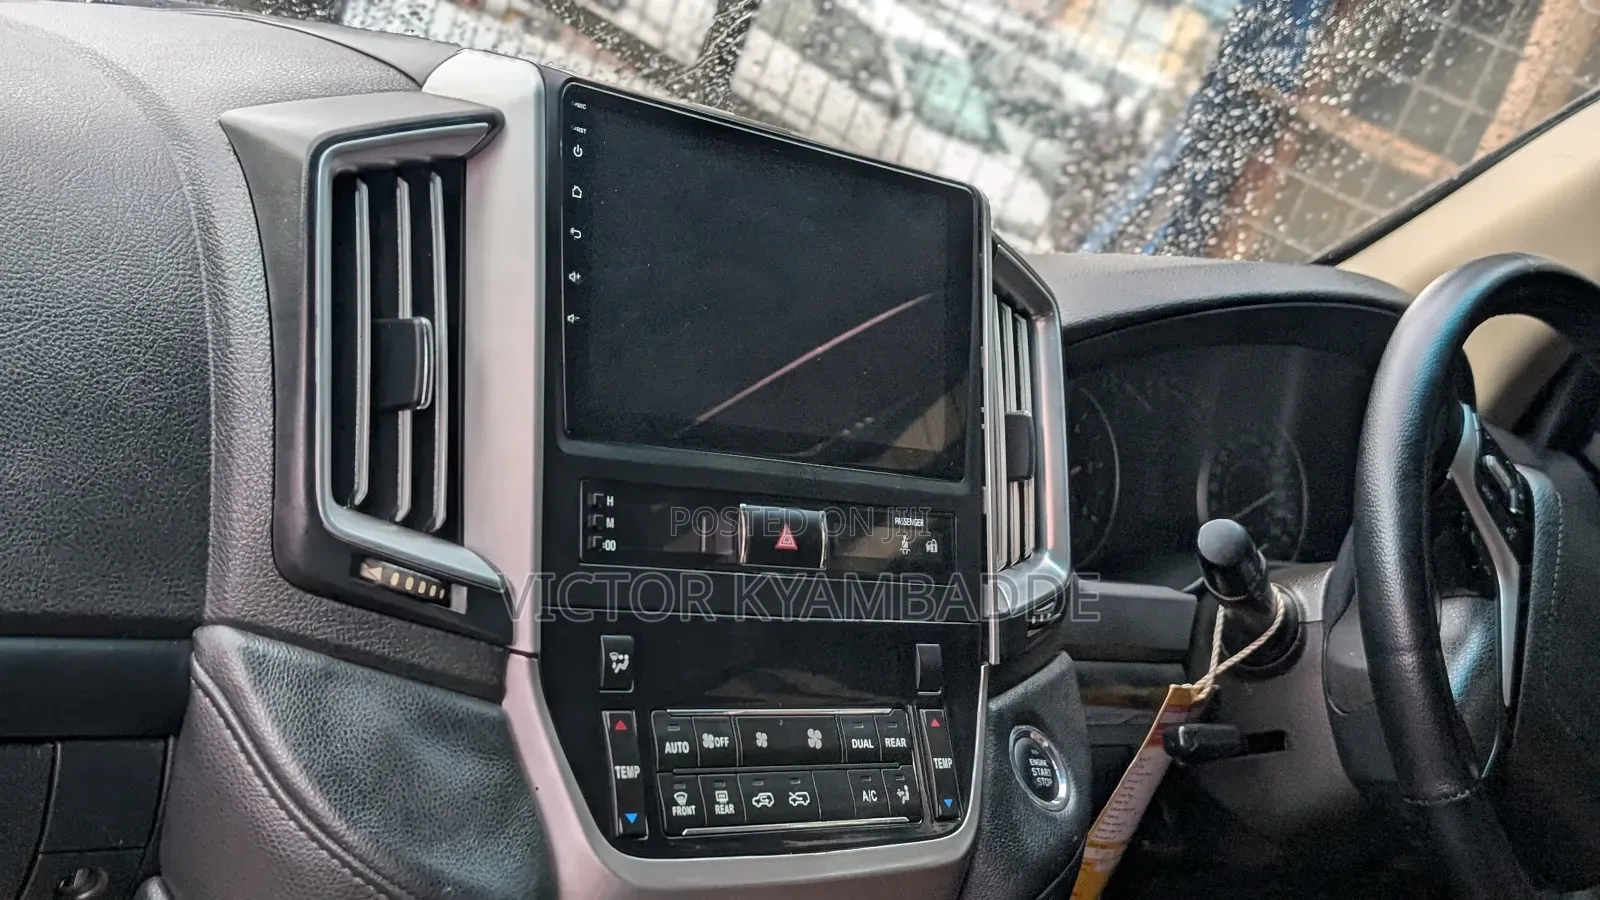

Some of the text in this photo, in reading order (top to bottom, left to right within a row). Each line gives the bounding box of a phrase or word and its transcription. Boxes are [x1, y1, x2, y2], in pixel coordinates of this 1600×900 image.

[606, 495, 614, 507] H
[605, 516, 615, 529] M
[894, 516, 925, 527] PASSENGER
[664, 740, 690, 754] AUTO
[714, 736, 730, 749] OFF
[851, 738, 875, 749] DUAL
[885, 737, 907, 748] REAR
[933, 757, 953, 770] TEMP
[1028, 758, 1049, 767] ENGINE
[614, 765, 640, 780] TEMP
[1031, 767, 1052, 777] START
[1036, 777, 1053, 787] STOP
[862, 789, 878, 802] A/C
[671, 805, 696, 817] FRONT
[714, 804, 735, 815] REAR
